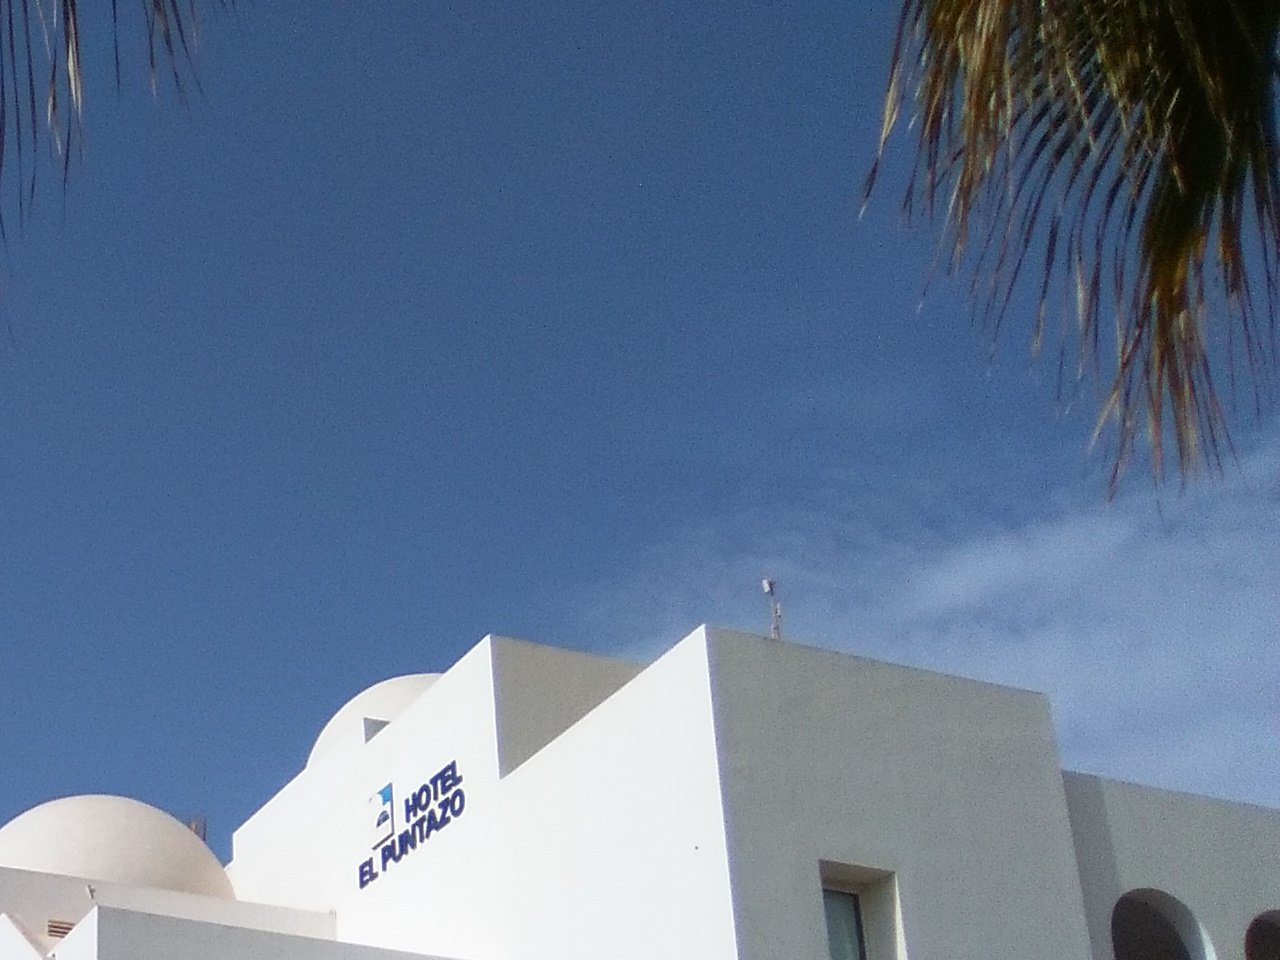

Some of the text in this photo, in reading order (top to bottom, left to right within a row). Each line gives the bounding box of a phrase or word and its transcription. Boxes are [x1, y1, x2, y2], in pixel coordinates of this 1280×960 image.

[404, 760, 463, 823] HOTEL
[358, 788, 465, 889] EL PUNTAZO
